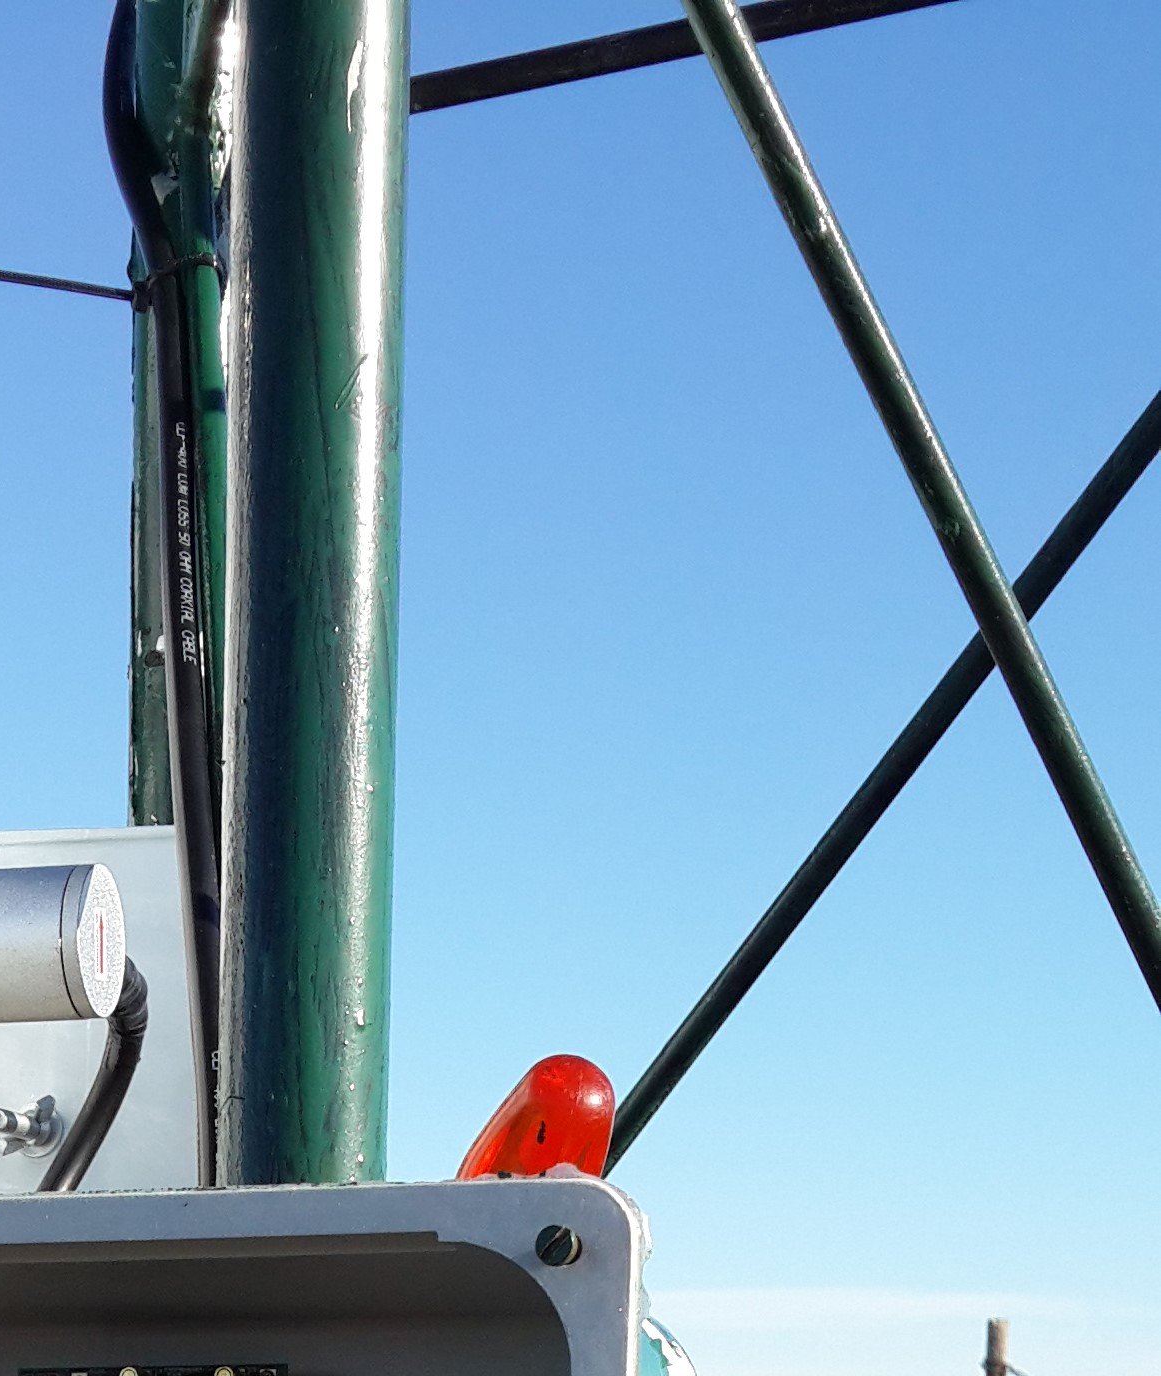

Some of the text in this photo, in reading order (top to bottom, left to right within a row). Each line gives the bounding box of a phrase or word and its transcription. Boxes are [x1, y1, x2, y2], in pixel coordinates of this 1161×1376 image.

[177, 473, 189, 495] LOW
[177, 498, 190, 528] LOSS
[178, 531, 191, 546] 50
[179, 550, 193, 575] OHM
[180, 577, 195, 624] COAXIAL
[181, 630, 197, 666] CABLE
